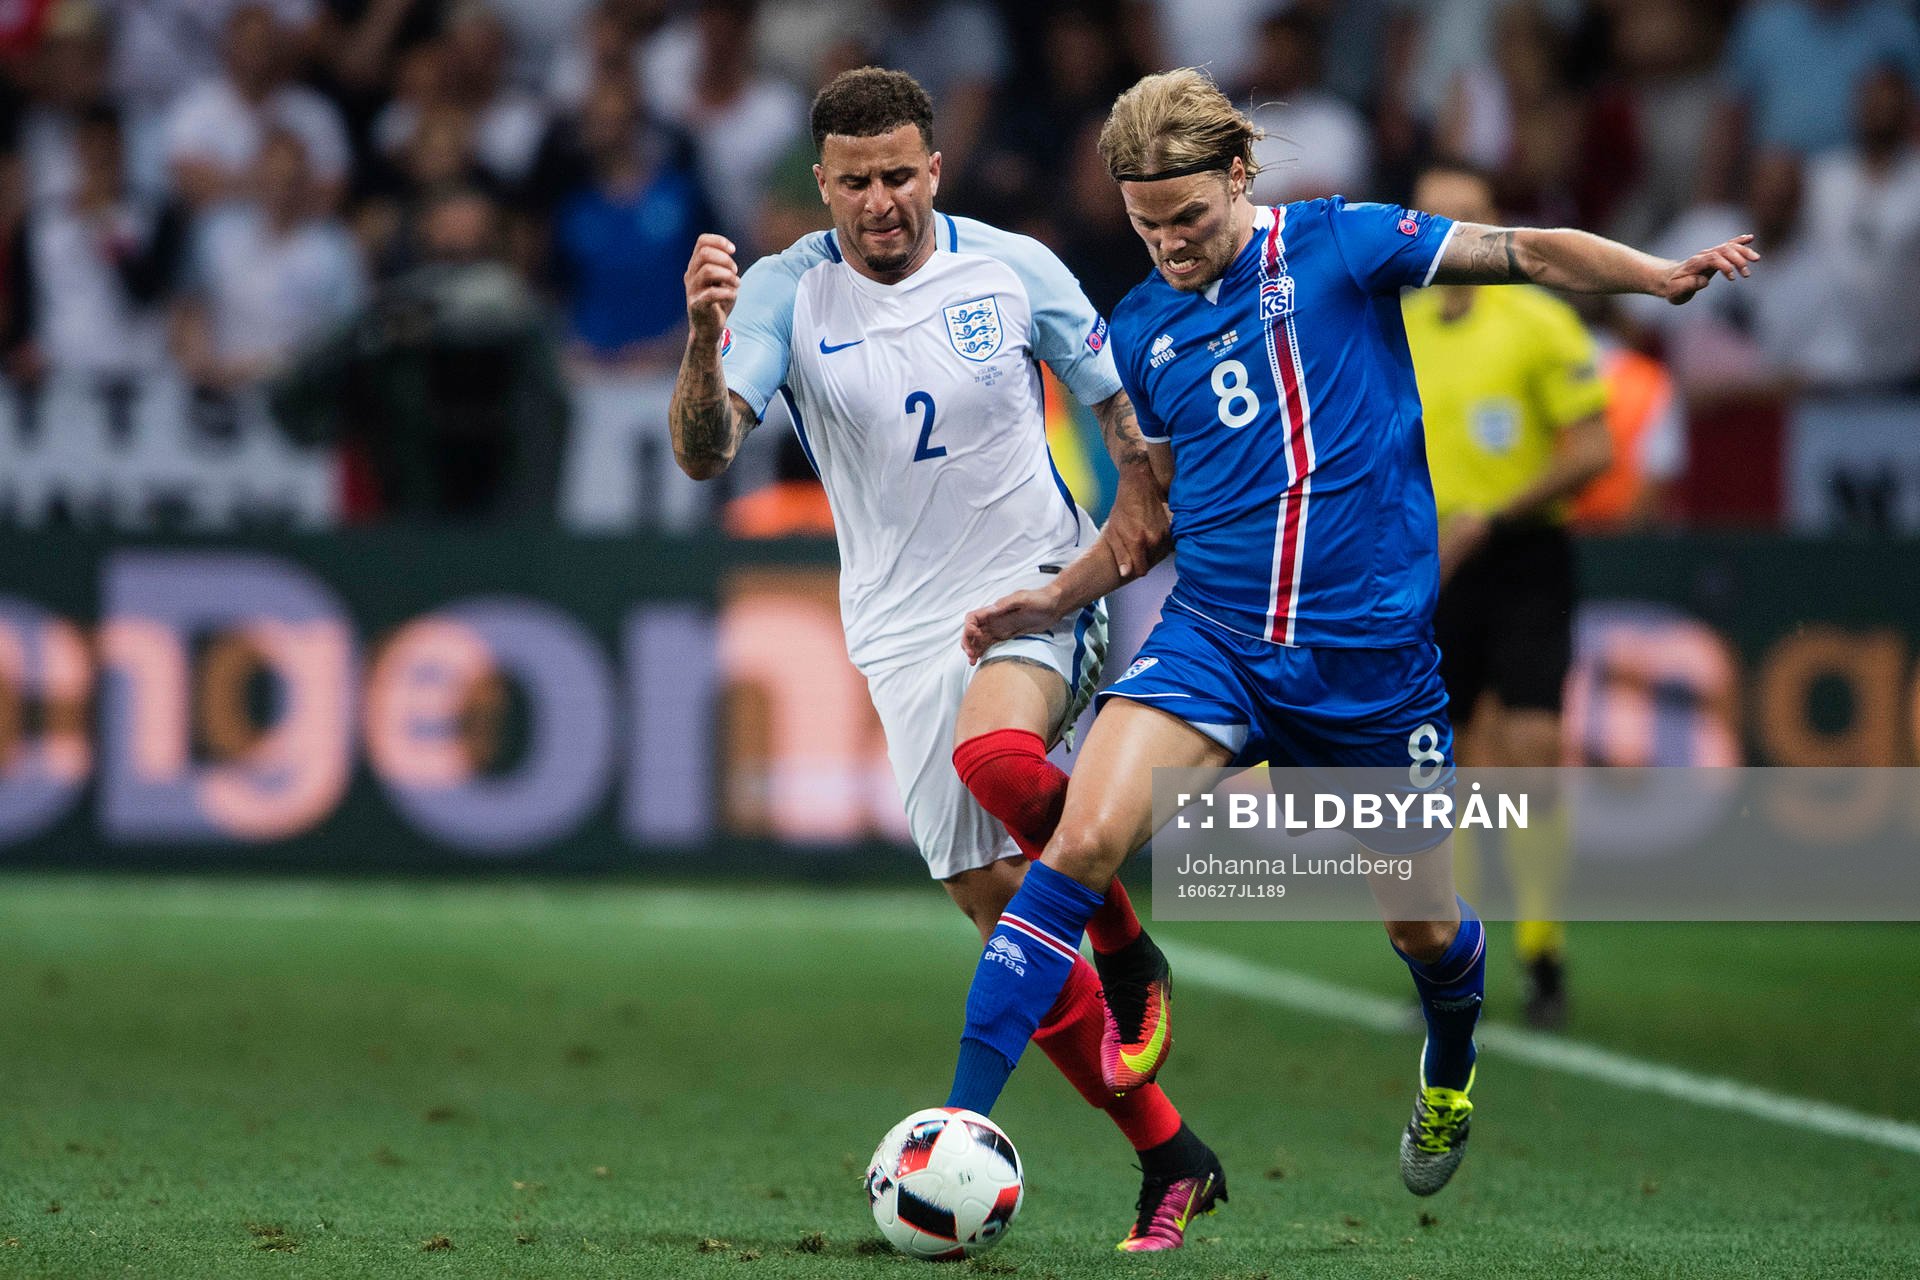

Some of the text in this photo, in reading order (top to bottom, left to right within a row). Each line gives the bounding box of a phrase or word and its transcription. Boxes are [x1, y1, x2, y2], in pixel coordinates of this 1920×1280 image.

[1149, 348, 1177, 368] errea
[904, 391, 948, 462] 2
[1210, 359, 1260, 429] 8
[1407, 723, 1445, 788] 8
[984, 951, 1026, 977] errea
